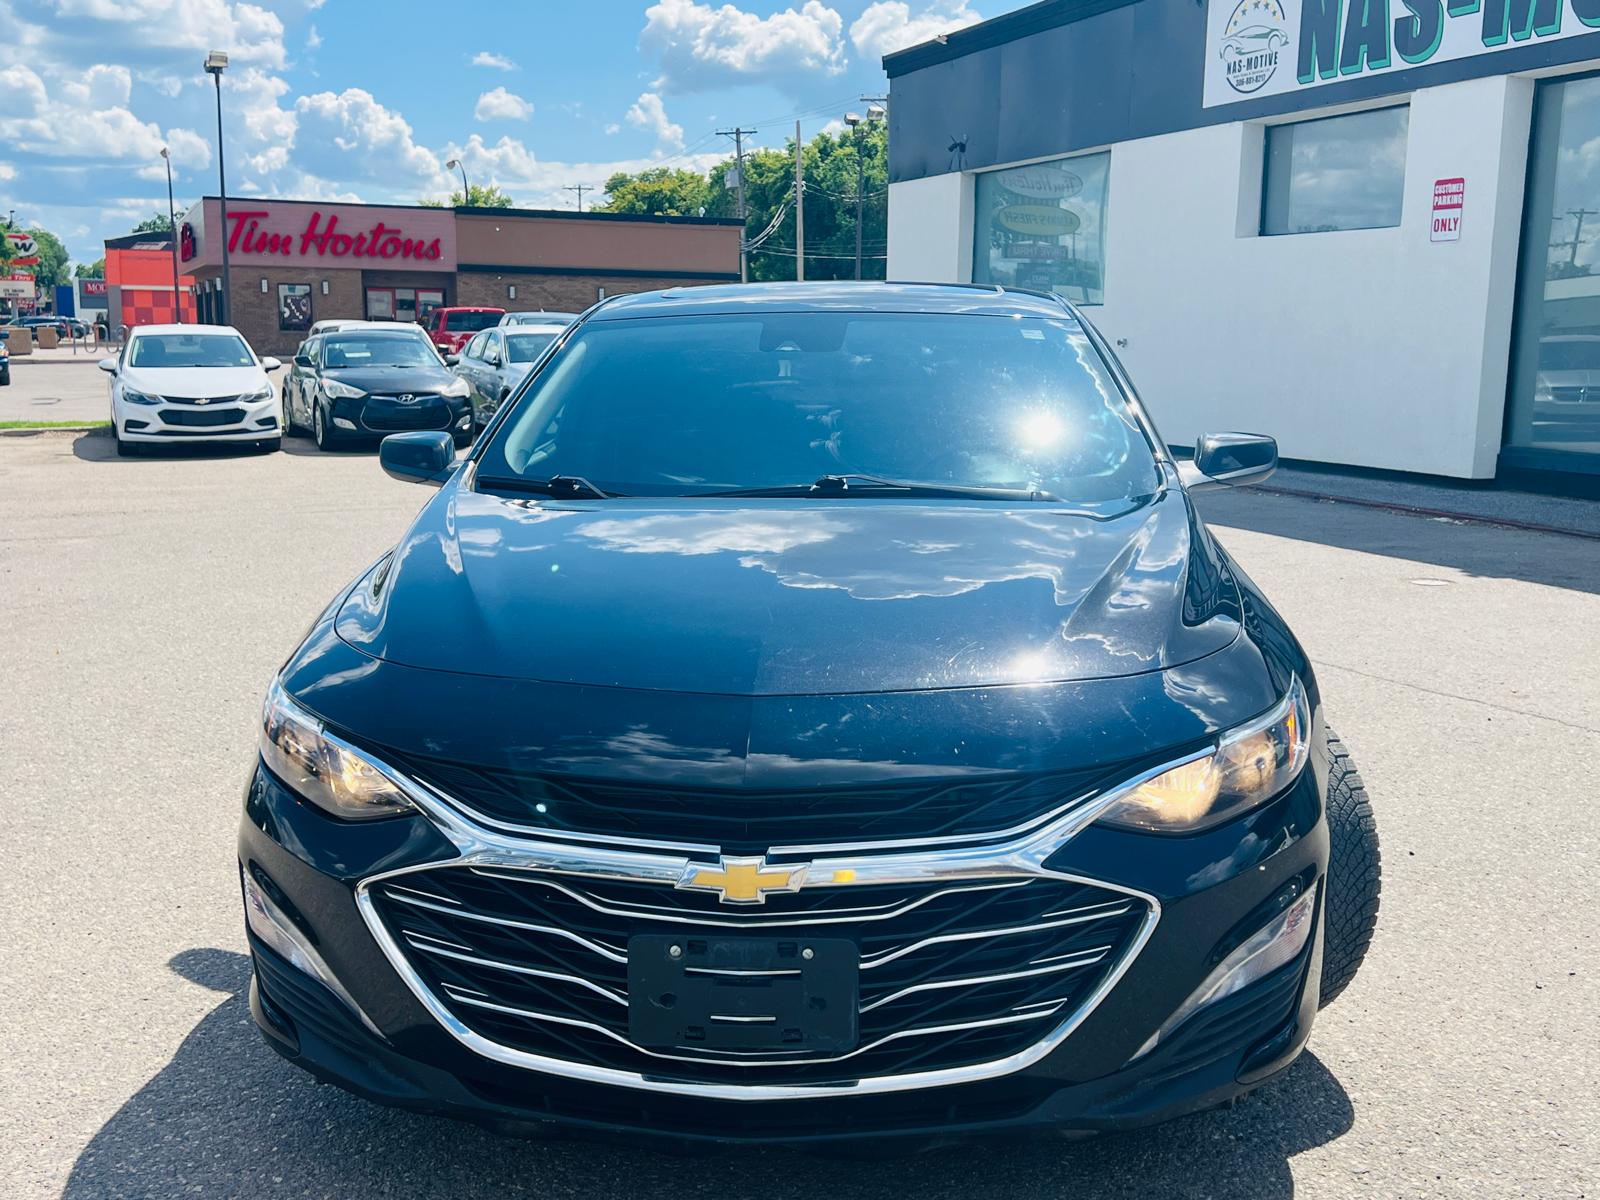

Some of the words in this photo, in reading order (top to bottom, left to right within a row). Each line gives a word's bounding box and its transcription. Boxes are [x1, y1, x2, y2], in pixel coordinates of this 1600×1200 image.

[1297, 0, 1600, 84] NAS-
[1226, 51, 1279, 75] NAS-MOTIVE
[1435, 183, 1463, 195] CUSTOMER
[1434, 194, 1462, 206] PARKING
[1433, 217, 1459, 233] ONLY
[227, 211, 293, 256] Tim
[300, 211, 441, 261] Hortons
[14, 242, 33, 252] W
